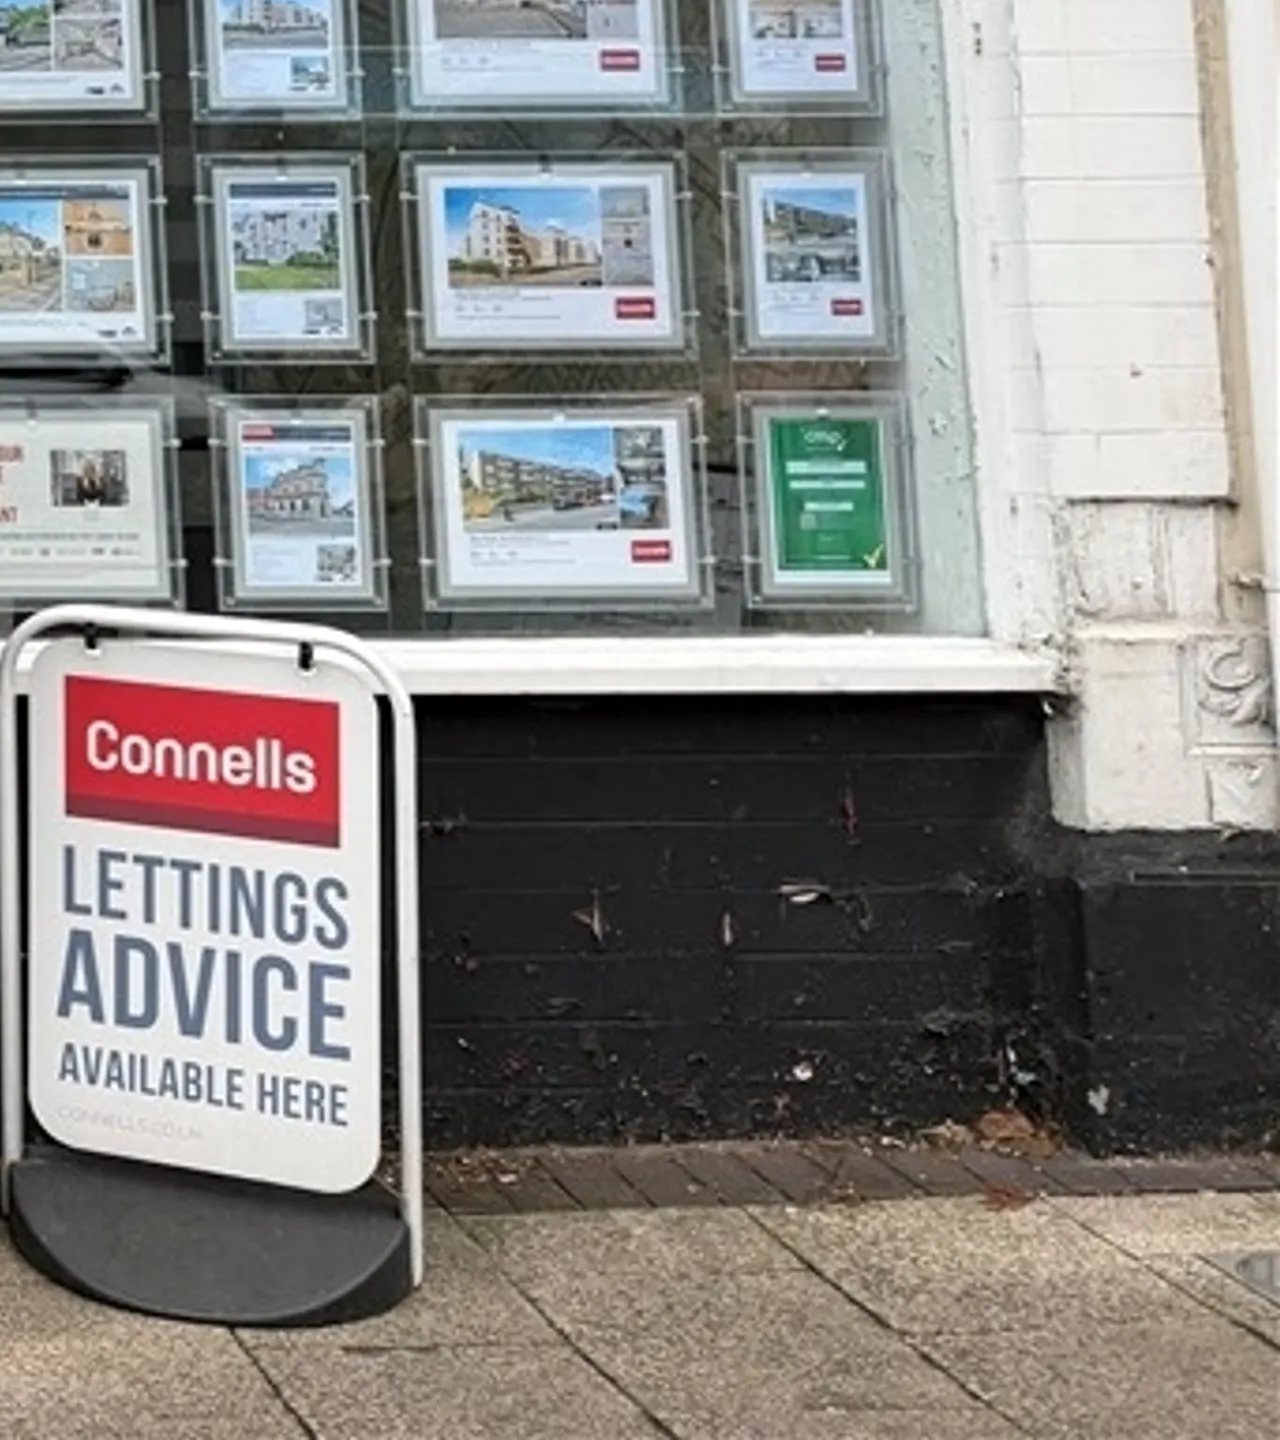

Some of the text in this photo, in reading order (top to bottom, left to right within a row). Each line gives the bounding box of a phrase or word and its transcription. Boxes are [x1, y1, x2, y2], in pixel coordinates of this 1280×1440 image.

[86, 720, 317, 794] Connells
[62, 844, 349, 951] LETTINGS
[56, 927, 352, 1062] ADVICE
[57, 1041, 348, 1128] AVAILABLE HERE
